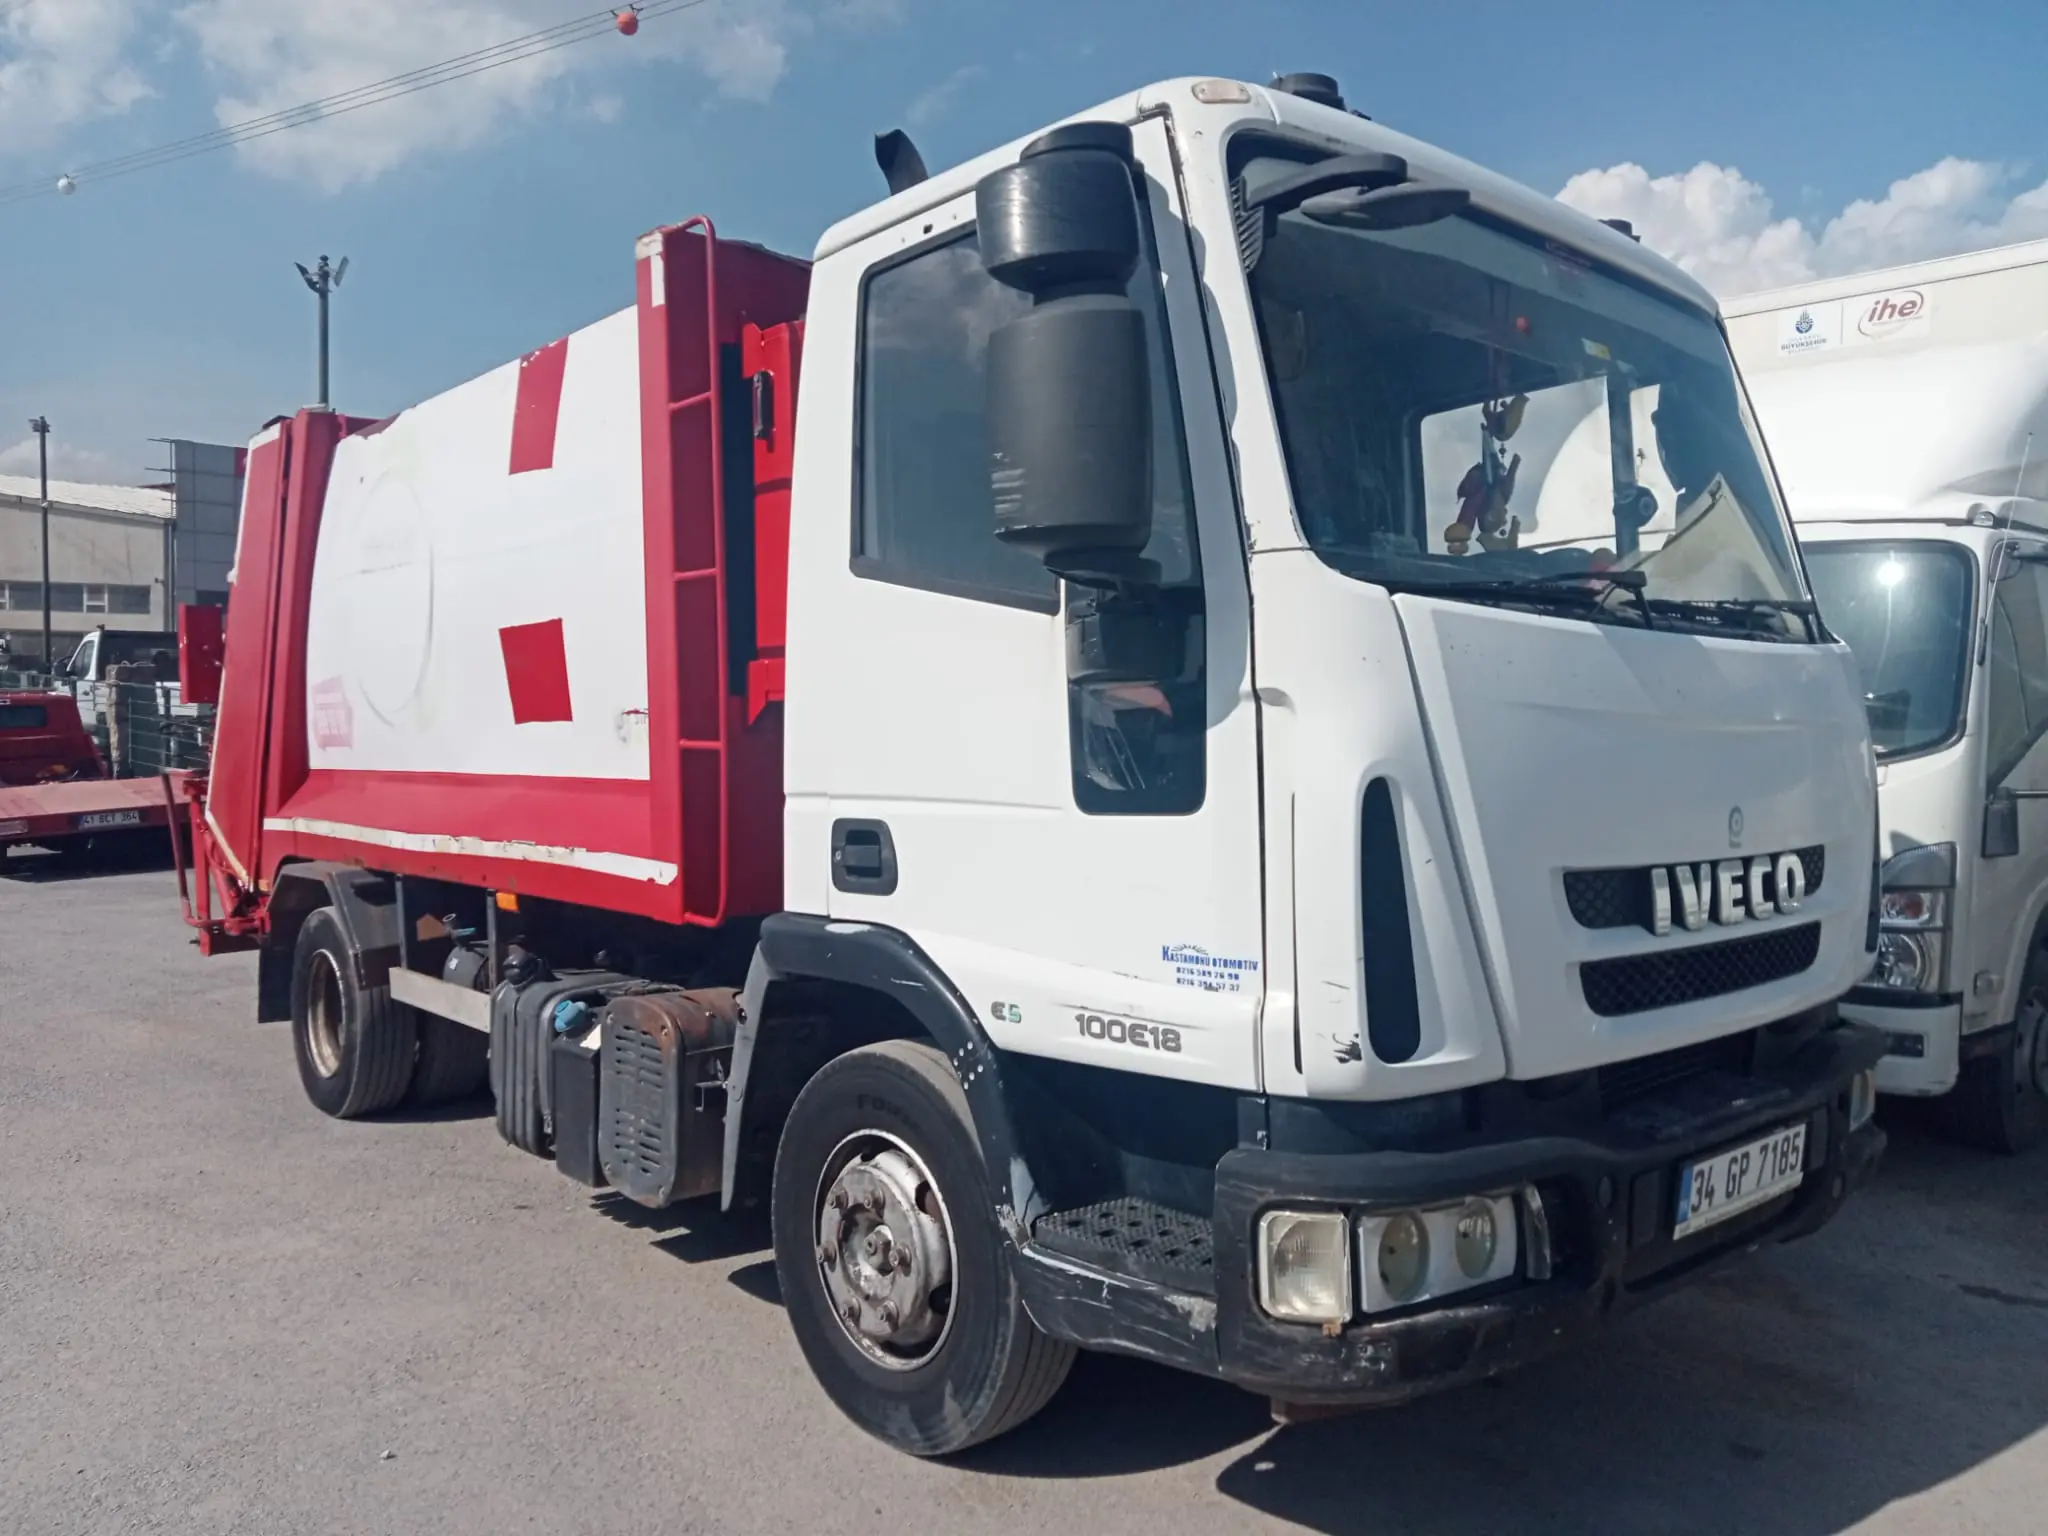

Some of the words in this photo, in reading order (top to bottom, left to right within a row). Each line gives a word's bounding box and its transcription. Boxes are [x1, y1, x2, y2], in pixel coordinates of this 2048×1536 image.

[1651, 853, 1805, 936] IVECO
[1075, 1013, 1182, 1053] 100E18
[1690, 1165, 1715, 1214] 34
[1725, 1151, 1750, 1199] GP
[1757, 1130, 1802, 1188] 7185
